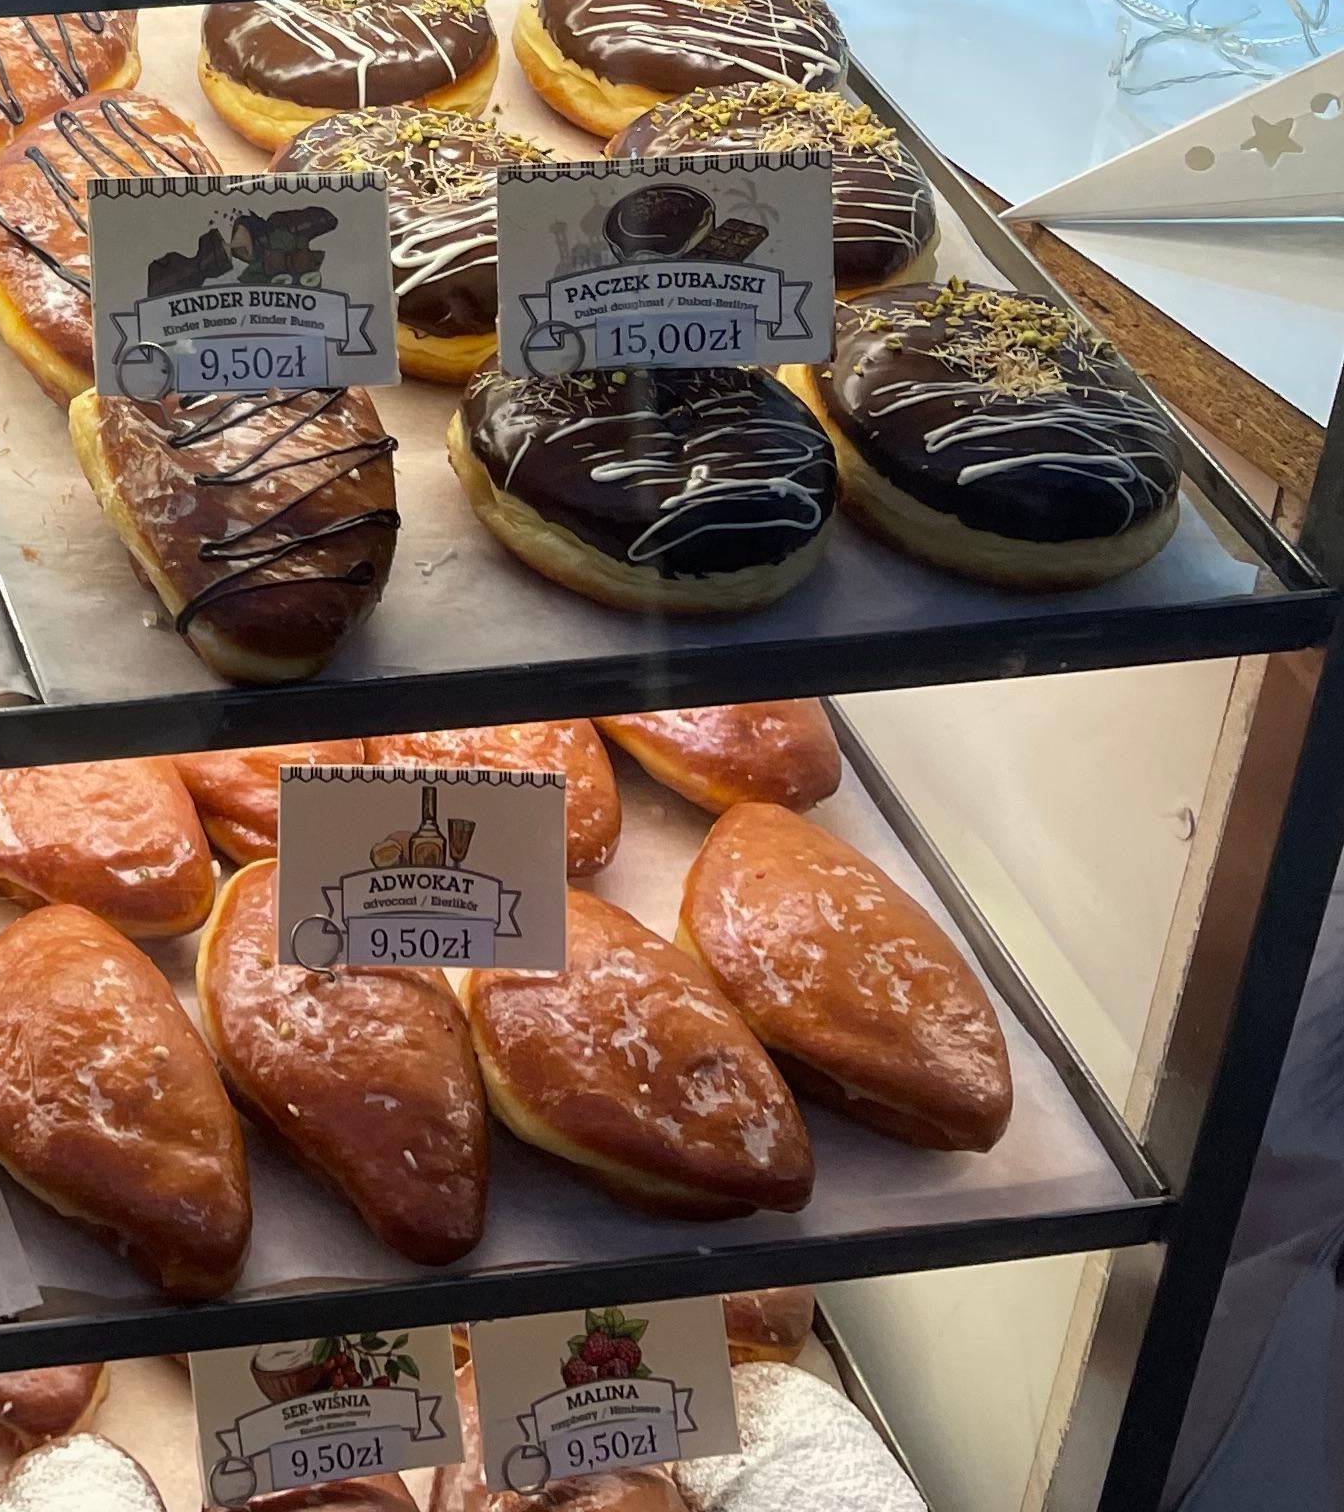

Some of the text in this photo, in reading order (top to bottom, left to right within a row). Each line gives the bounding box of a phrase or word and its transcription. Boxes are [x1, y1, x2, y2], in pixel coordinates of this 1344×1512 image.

[169, 290, 317, 317] KINDER BUENO
[565, 272, 765, 304] PĄCZEK DUBAJSKI
[163, 321, 200, 336] Kinder
[203, 316, 237, 327] Bueno
[611, 319, 742, 360] 15,00zł
[200, 345, 307, 387] 9,50zł
[369, 874, 474, 894] ADWOKAT
[371, 928, 471, 963] 9,50zł
[282, 1392, 370, 1420] SER-WIŚNIA
[566, 1384, 639, 1410] MALINA
[291, 1437, 383, 1479] 9,50zł
[567, 1425, 657, 1469] 9,50zł
